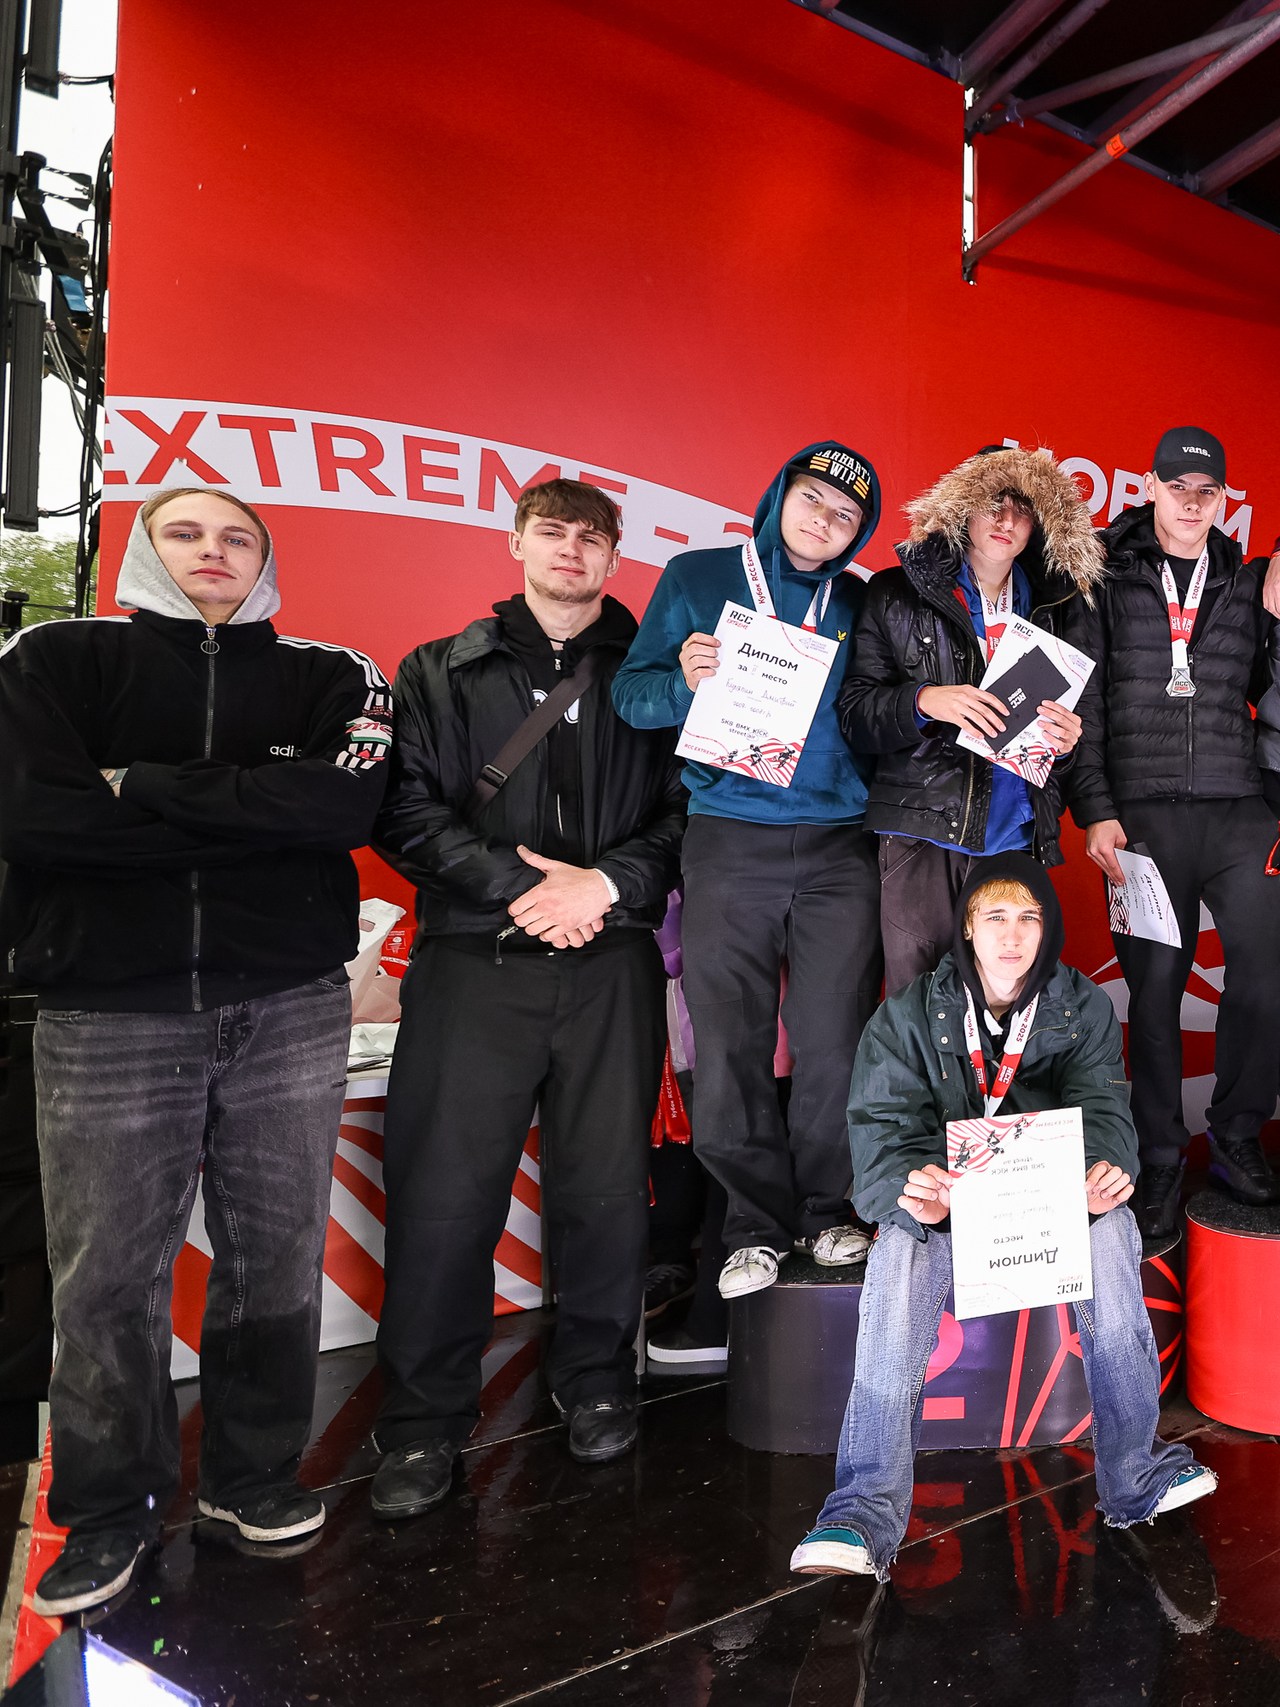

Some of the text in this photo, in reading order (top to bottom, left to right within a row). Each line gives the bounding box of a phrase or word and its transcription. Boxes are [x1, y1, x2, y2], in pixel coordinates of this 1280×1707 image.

[1182, 445, 1211, 457] vans.
[103, 408, 628, 541] XTREM
[829, 460, 856, 486] WIP
[750, 566, 759, 582] RCC
[729, 609, 754, 625] RCC
[1014, 622, 1034, 637] RCC
[737, 641, 799, 672] Диплом
[737, 664, 748, 672] за
[761, 672, 788, 685] место
[728, 728, 747, 737] street
[735, 724, 751, 732] BMX
[1016, 1023, 1028, 1042] 2025
[991, 1167, 1009, 1176] KICK
[993, 1230, 1052, 1245] за место
[989, 1246, 1059, 1270] Диплом
[1057, 1281, 1083, 1296] RCC
